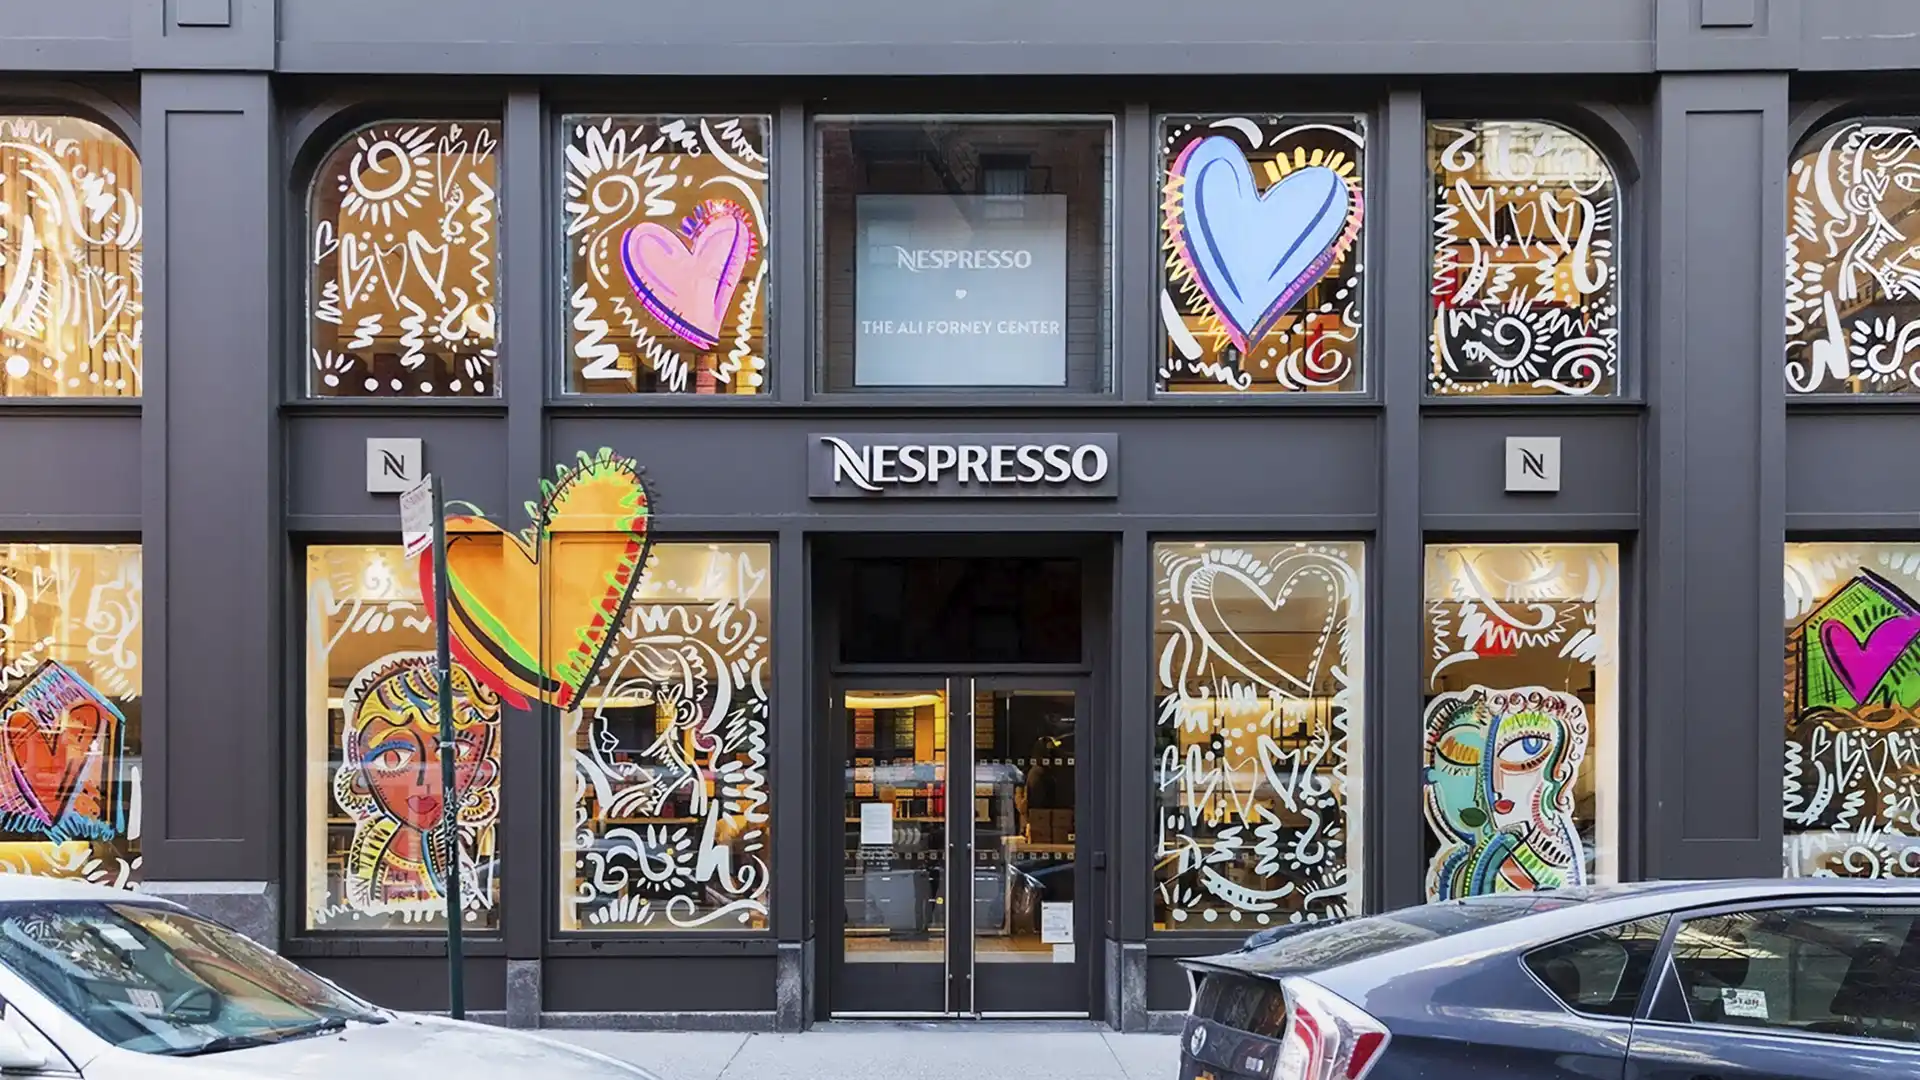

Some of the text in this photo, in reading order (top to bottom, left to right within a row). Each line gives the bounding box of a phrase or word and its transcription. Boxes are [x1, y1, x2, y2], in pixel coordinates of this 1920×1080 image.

[894, 245, 1032, 274] NESPRESSO
[862, 320, 1060, 335] THE ALI FORNEY CENTER
[378, 448, 412, 481] N
[820, 436, 1109, 491] NESPRESSO
[1516, 447, 1549, 480] N
